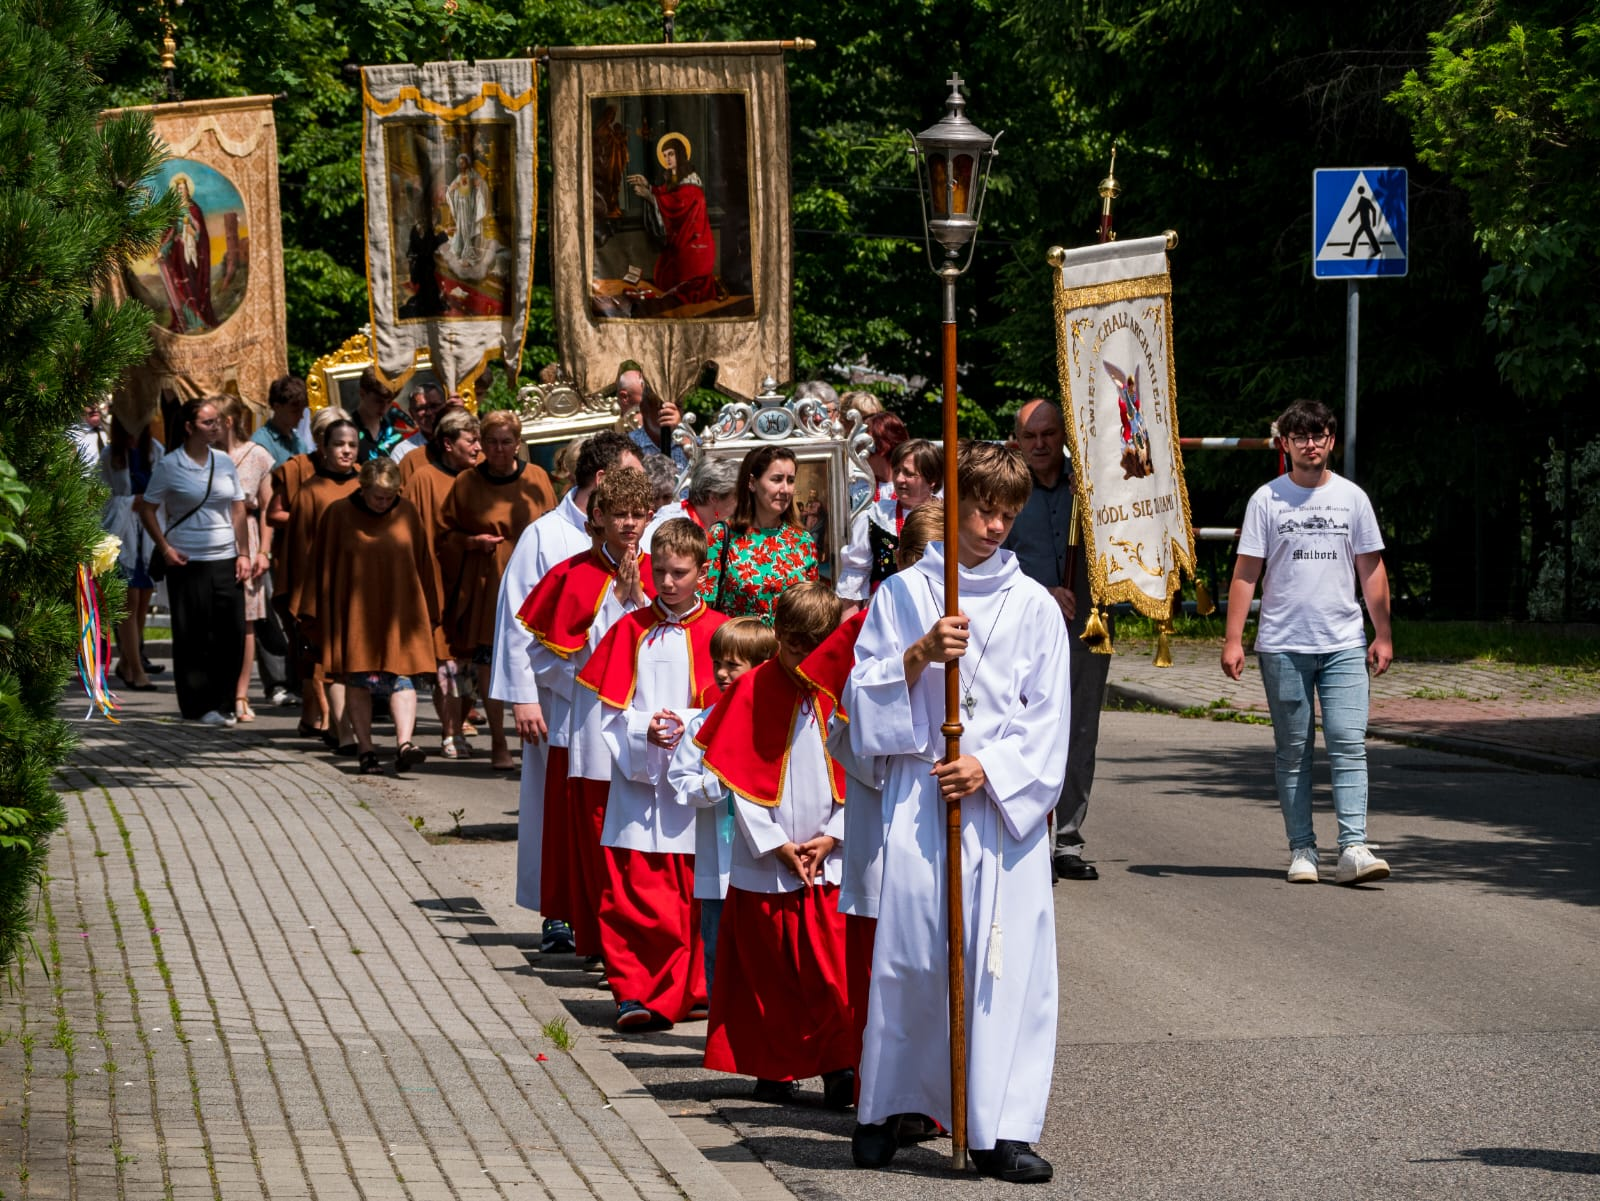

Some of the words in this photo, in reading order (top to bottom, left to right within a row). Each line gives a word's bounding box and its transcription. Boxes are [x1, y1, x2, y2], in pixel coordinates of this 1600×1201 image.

[1096, 504, 1128, 527] MÓDL
[1132, 499, 1153, 519] SIĘ
[1292, 549, 1338, 560] Malbork
